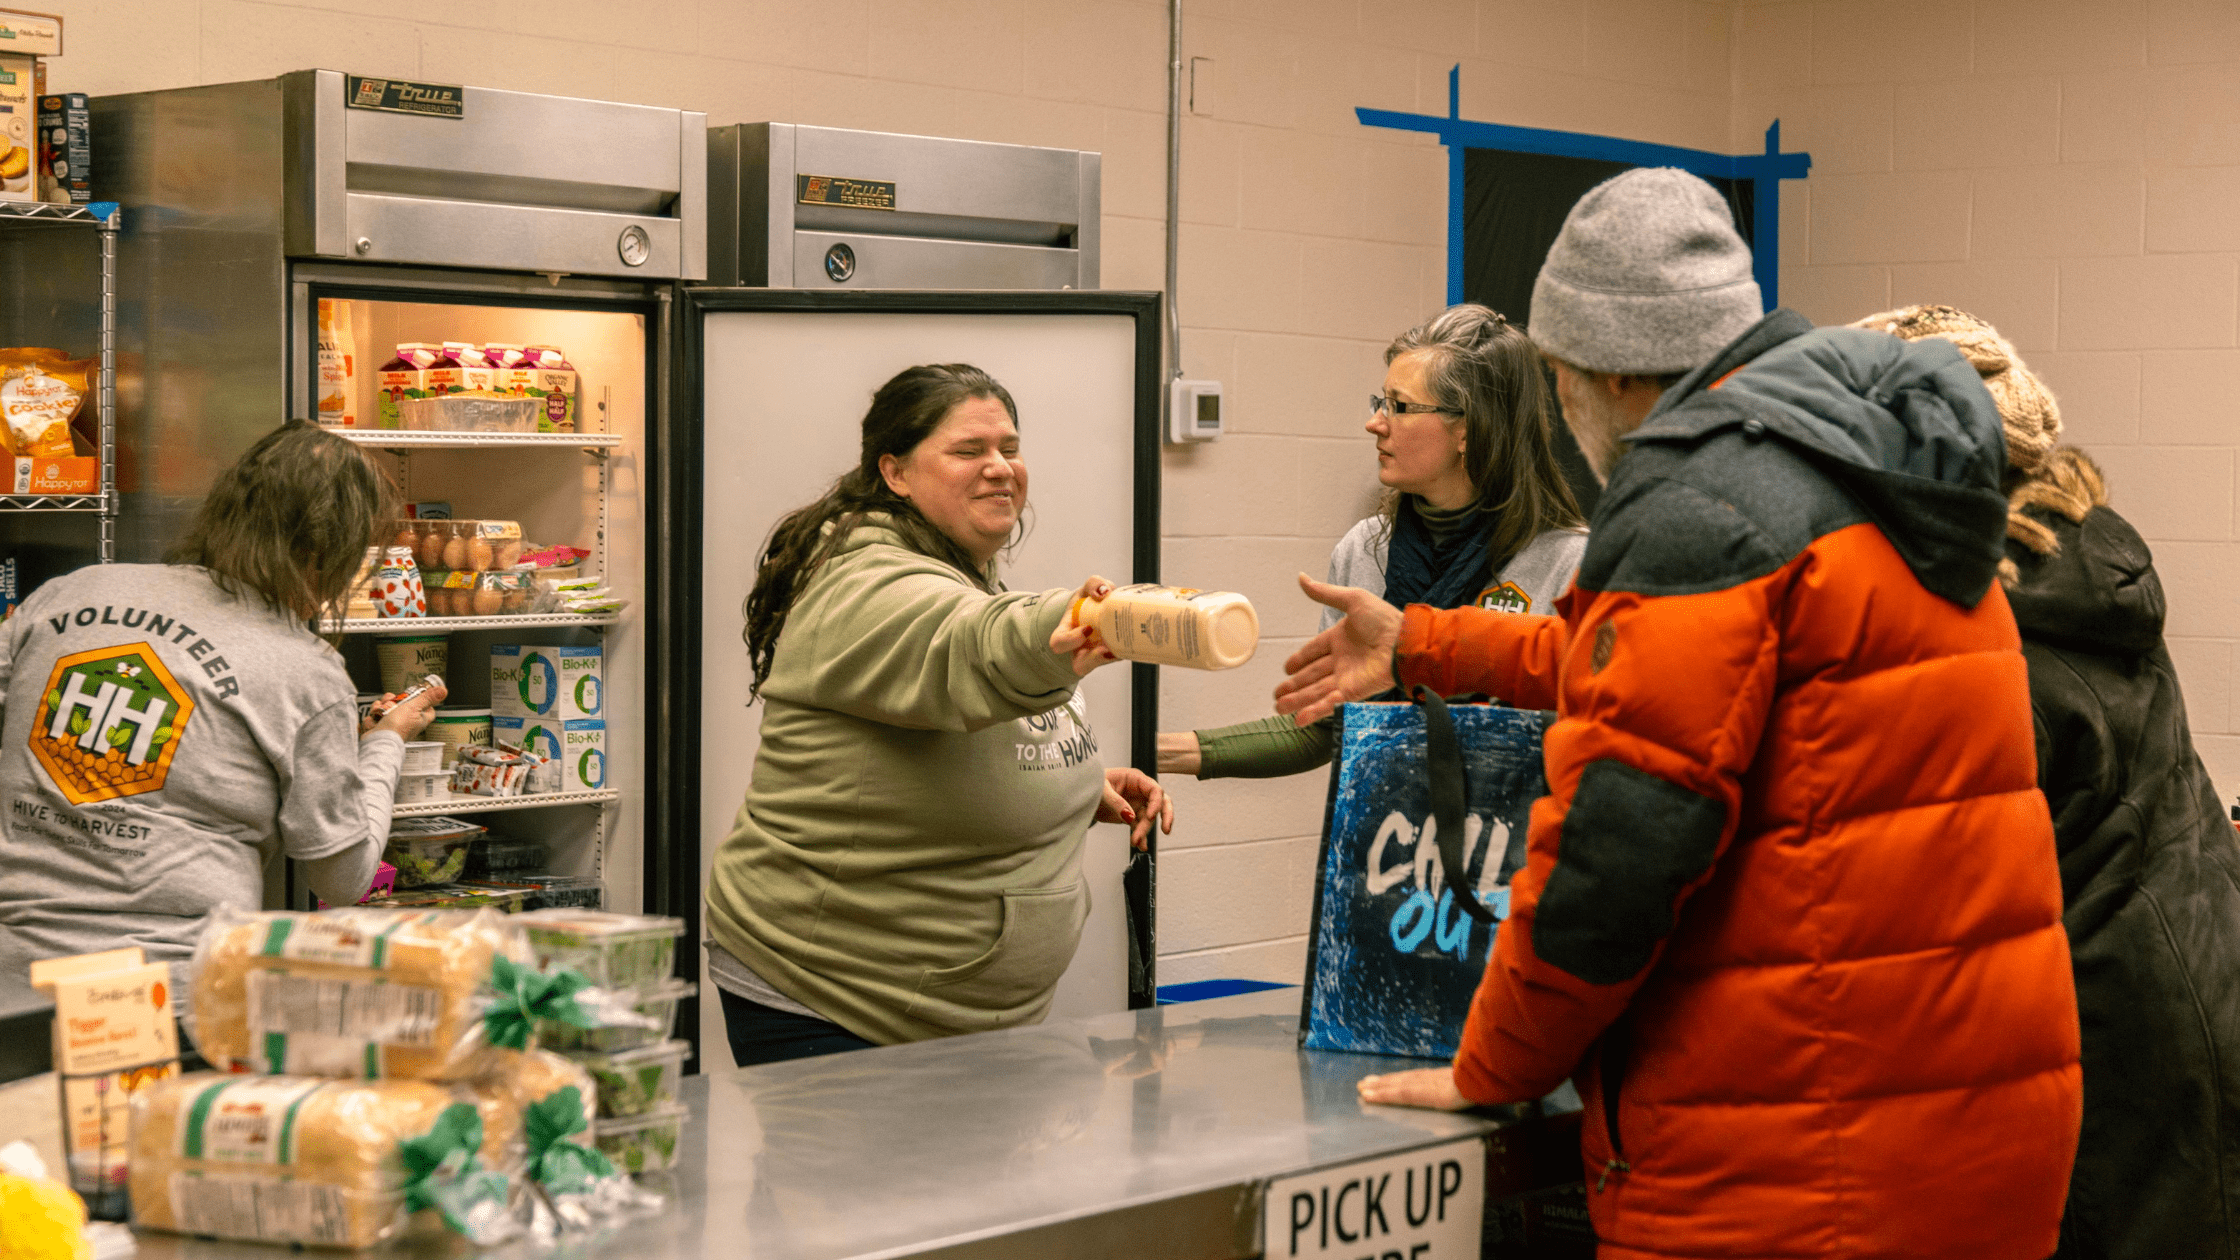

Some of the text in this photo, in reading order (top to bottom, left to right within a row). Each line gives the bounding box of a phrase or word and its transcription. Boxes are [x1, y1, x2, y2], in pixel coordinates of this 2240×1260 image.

[398, 101, 457, 113] REFRIGERATOR
[5, 557, 16, 599] SHELLS
[50, 605, 241, 701] VOLUNTEER
[50, 671, 168, 766] HH
[1015, 743, 1037, 762] TO
[1038, 742, 1060, 761] THE
[1018, 763, 1046, 772] ISAIAH
[11, 821, 29, 833] Food
[13, 800, 151, 840] HIVE TO HARVEST
[101, 804, 126, 814] 2024
[1366, 811, 1512, 906] CHIL
[1289, 1159, 1463, 1257] PICK UP
